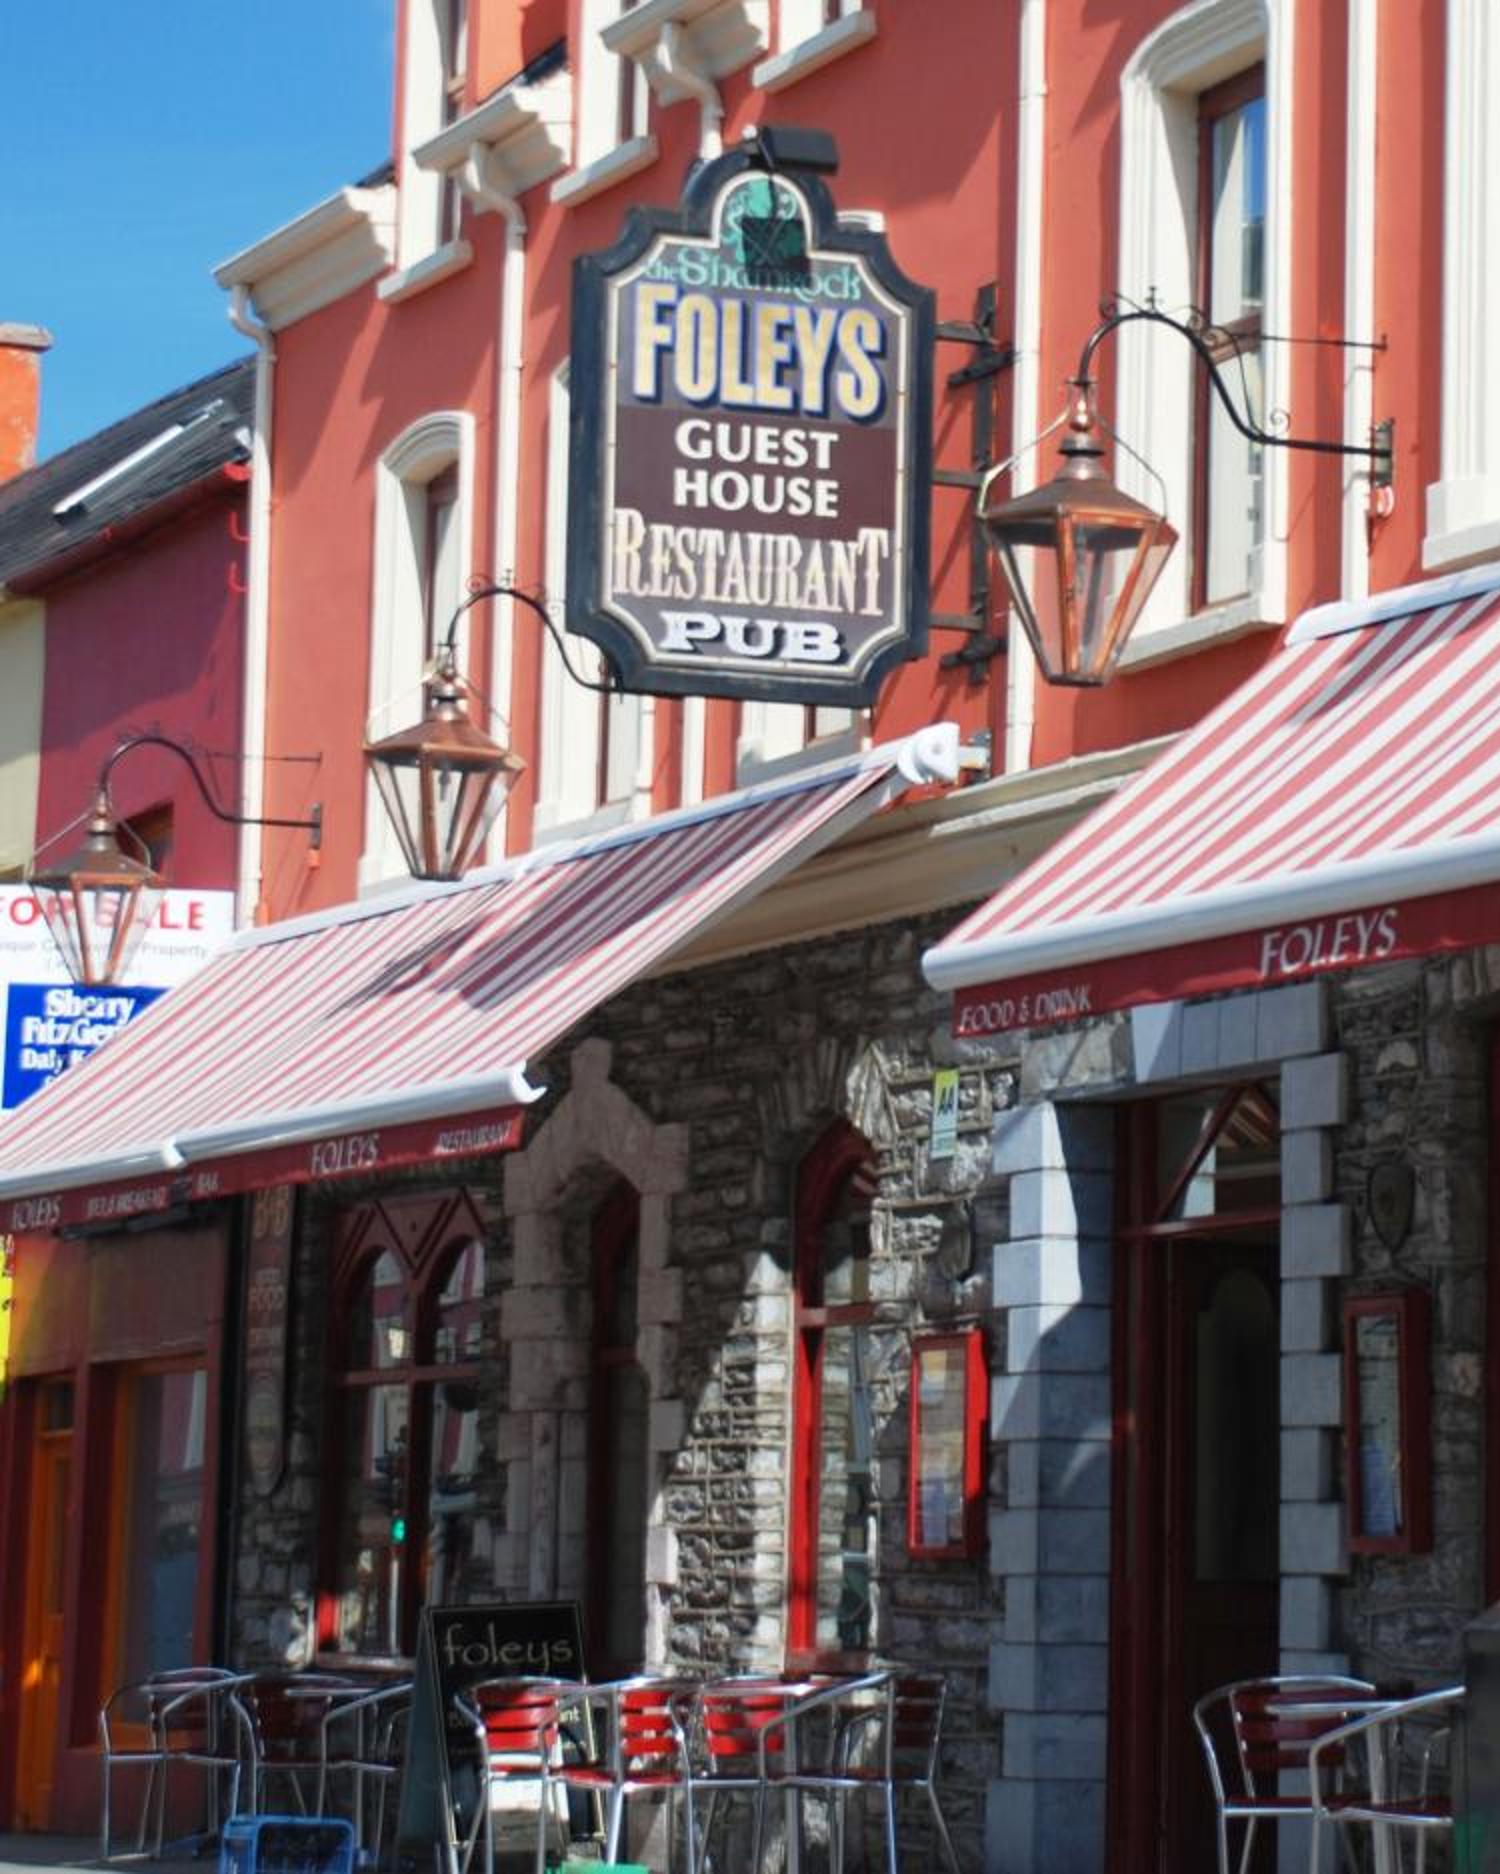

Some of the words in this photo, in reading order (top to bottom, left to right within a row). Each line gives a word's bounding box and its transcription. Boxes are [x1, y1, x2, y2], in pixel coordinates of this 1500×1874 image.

[633, 281, 884, 418] FOLEYS
[675, 419, 839, 470] GUEST
[673, 469, 839, 519] HOUSE
[612, 507, 890, 616] RESTAURANT
[658, 609, 842, 661] PUB
[0, 896, 76, 930] OR
[1260, 907, 1398, 977] FOLEYS
[45, 989, 136, 1026] Sherry
[959, 998, 1015, 1032] FOOD
[1034, 983, 1091, 1020] DRINK
[311, 1132, 380, 1176] FOLEYS
[444, 1621, 574, 1672] foleys
